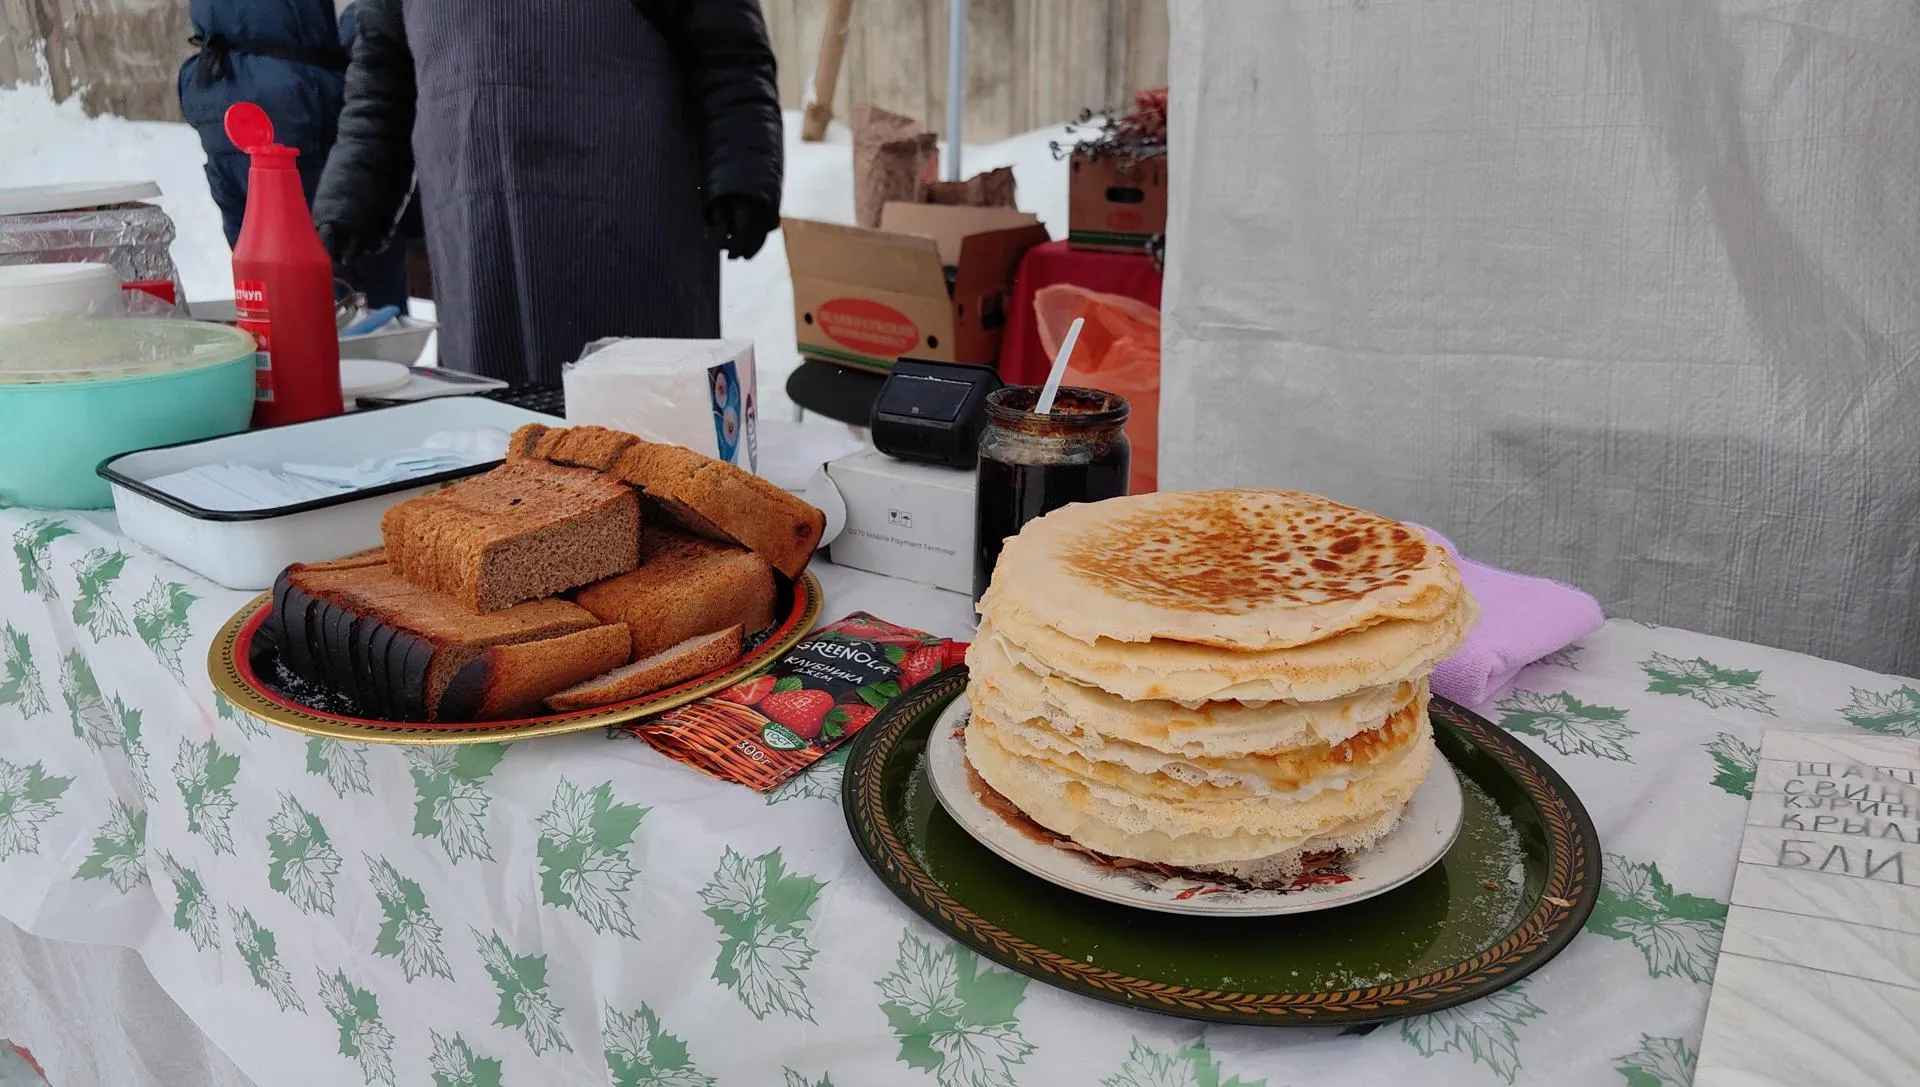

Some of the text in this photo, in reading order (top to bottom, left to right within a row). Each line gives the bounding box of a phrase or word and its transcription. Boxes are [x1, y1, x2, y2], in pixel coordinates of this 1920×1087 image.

[867, 531, 890, 543] Mobile
[890, 536, 922, 549] Payment
[924, 543, 956, 556] Terminal
[784, 655, 864, 685] КЛУБНИКА
[797, 641, 892, 675] GREENOLA
[792, 666, 833, 683] ДЖЕМ
[1781, 813, 1920, 844] КРЫЛ
[1778, 839, 1904, 885] БЛИ
